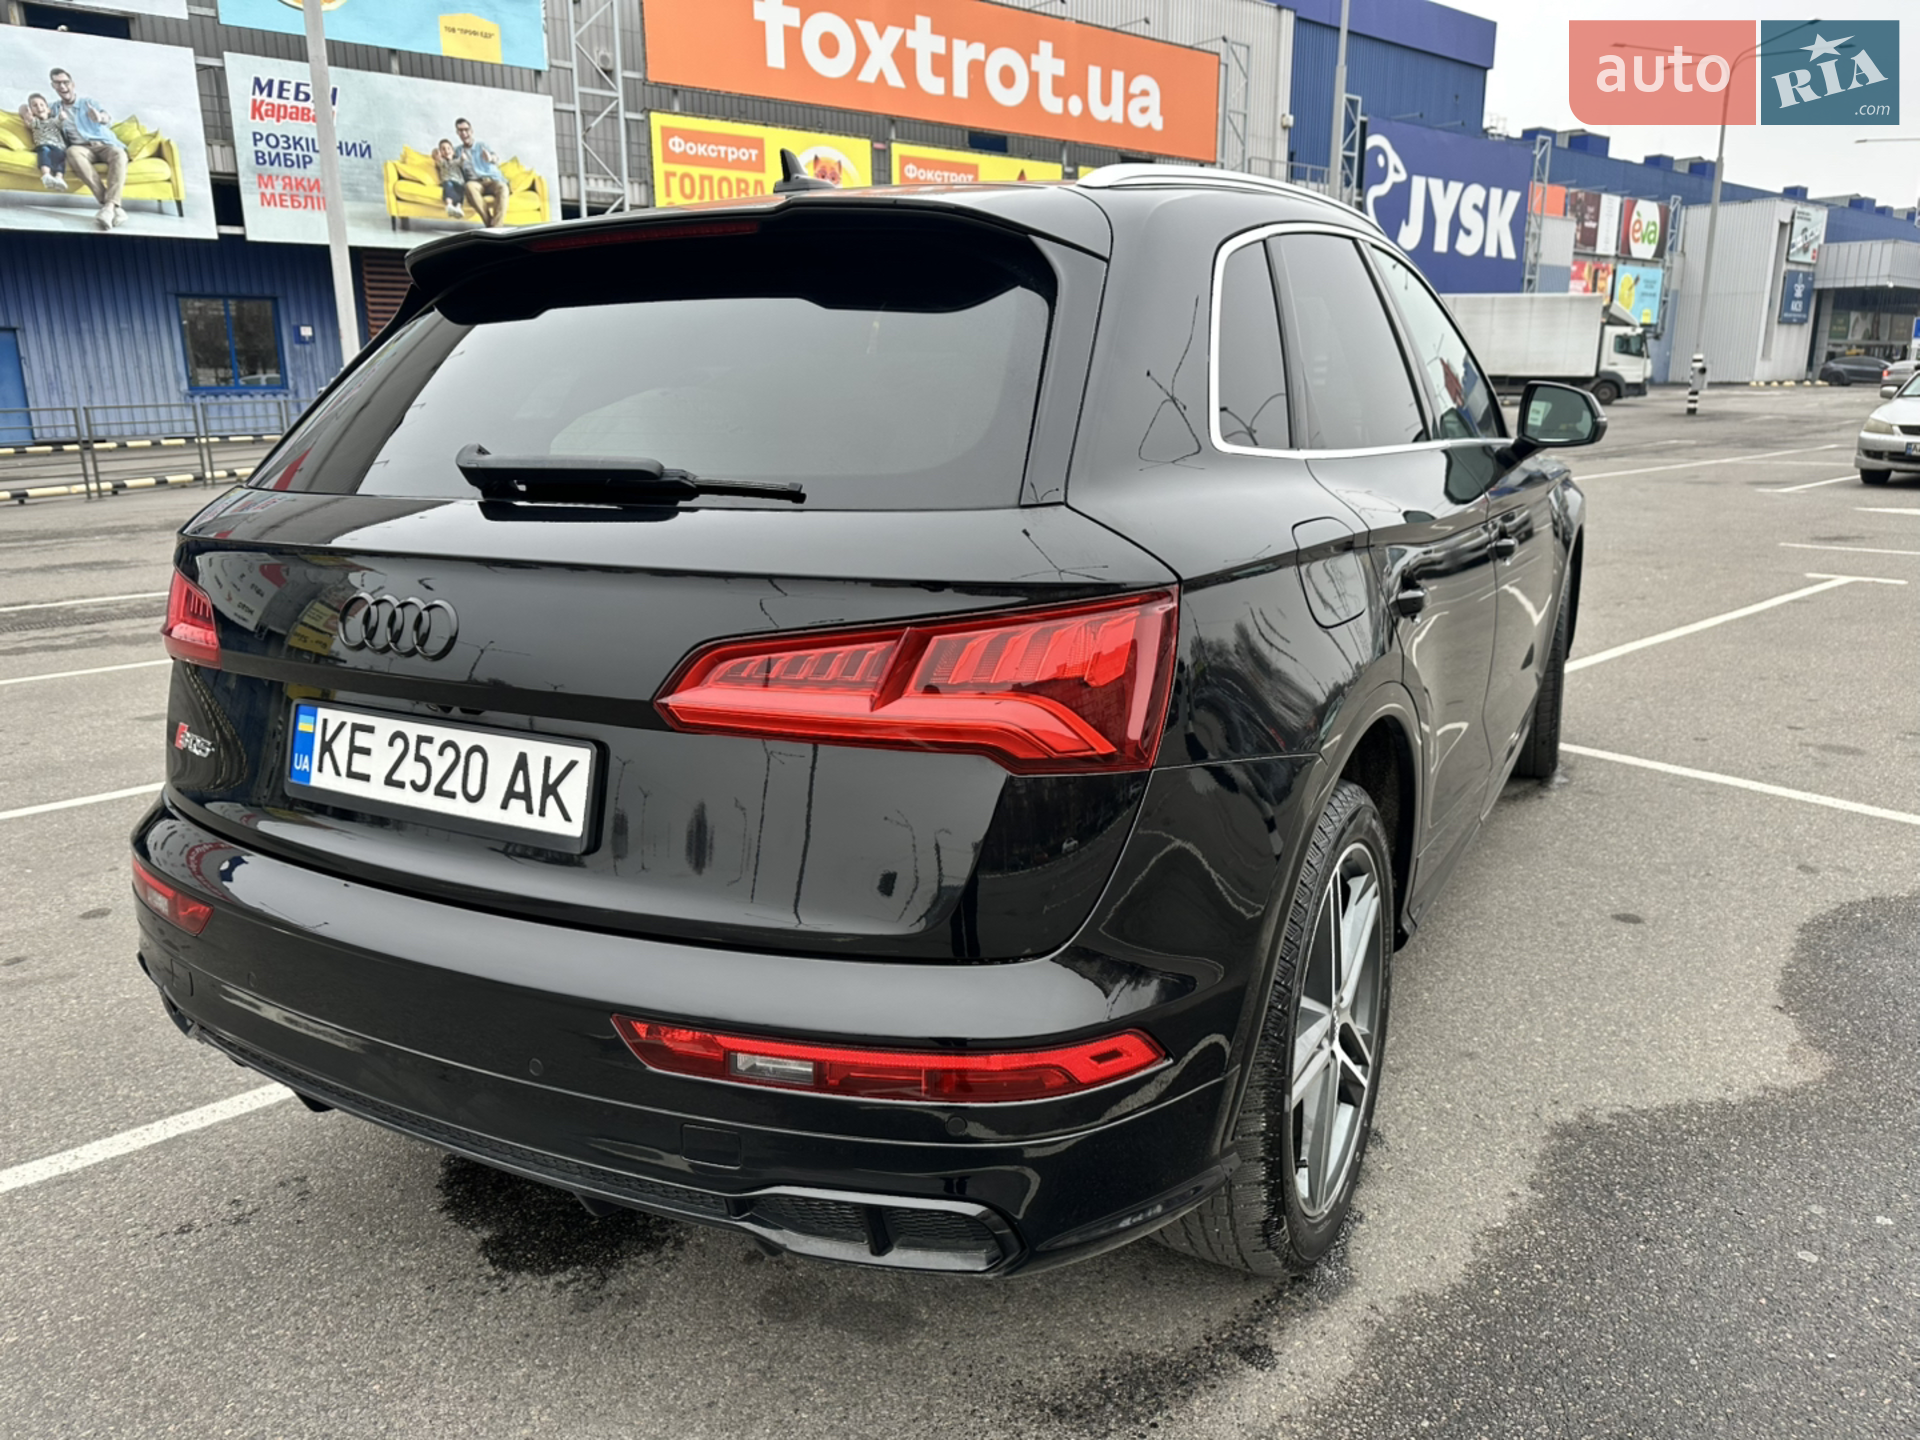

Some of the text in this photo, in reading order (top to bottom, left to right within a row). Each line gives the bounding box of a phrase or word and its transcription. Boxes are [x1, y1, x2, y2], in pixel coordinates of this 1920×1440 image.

[752, 0, 1163, 131] foxtrot.ua
[252, 76, 338, 106] МЕБІ
[254, 150, 313, 169] ВИБІР
[668, 136, 758, 162] Фокстрот
[257, 173, 323, 193] М'ЯКИ
[1397, 175, 1521, 260] JYSK
[294, 753, 309, 772] UA
[317, 718, 579, 823] KE 2520 AK
